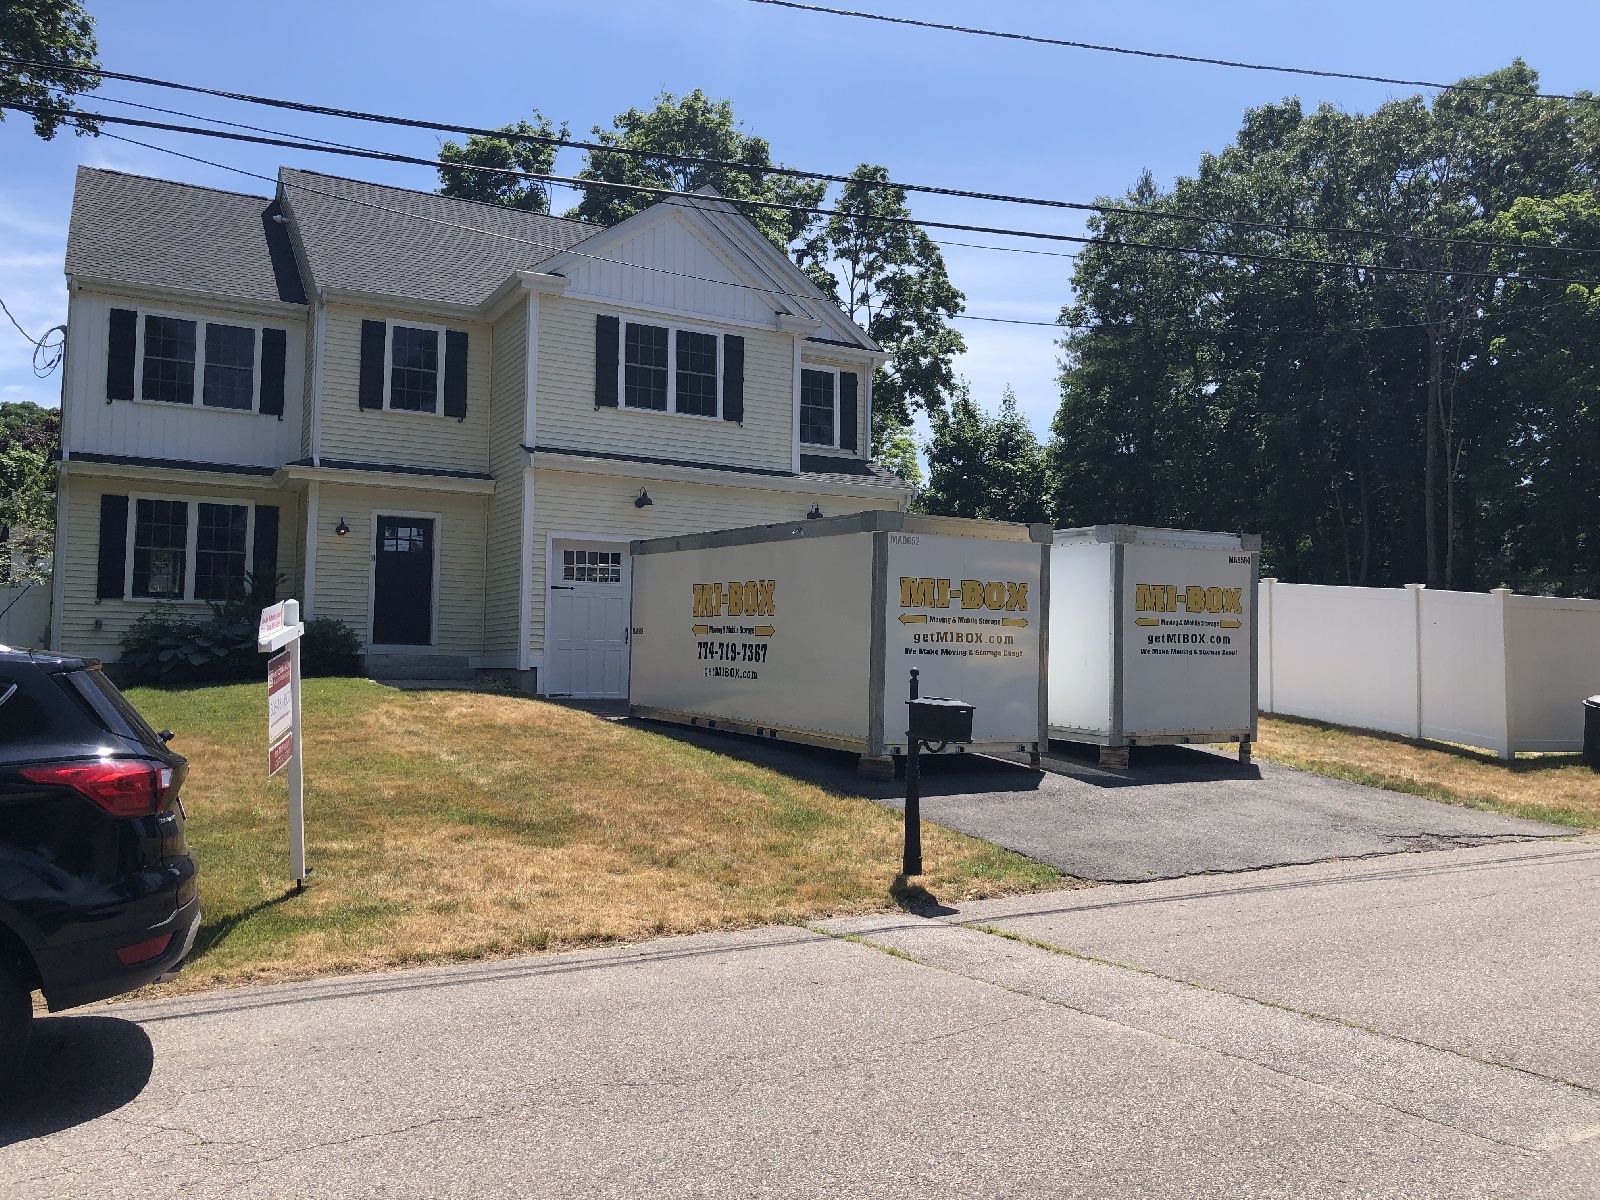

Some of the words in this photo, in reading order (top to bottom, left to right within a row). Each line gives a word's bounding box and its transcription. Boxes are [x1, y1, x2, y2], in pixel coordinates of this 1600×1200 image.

[692, 579, 776, 618] MI-BOX
[899, 576, 1029, 612] MI-BOX
[1135, 583, 1243, 614] MI-BOX
[929, 616, 951, 625] Moving
[952, 616, 957, 624] &
[958, 617, 978, 625] Mobile
[978, 617, 1001, 626] Storage
[1160, 619, 1178, 627] Moving
[1201, 620, 1220, 628] Storage
[913, 631, 1014, 645] getMIBOX.com
[1147, 633, 1231, 645] getMIBOX.com
[697, 641, 768, 663] 774-719-7367
[904, 647, 917, 655] We
[918, 647, 939, 656] Make
[940, 648, 967, 657] Moving
[975, 649, 1002, 658] Storage
[1170, 648, 1192, 656] Moving
[704, 666, 758, 680] getMIBOX.com
